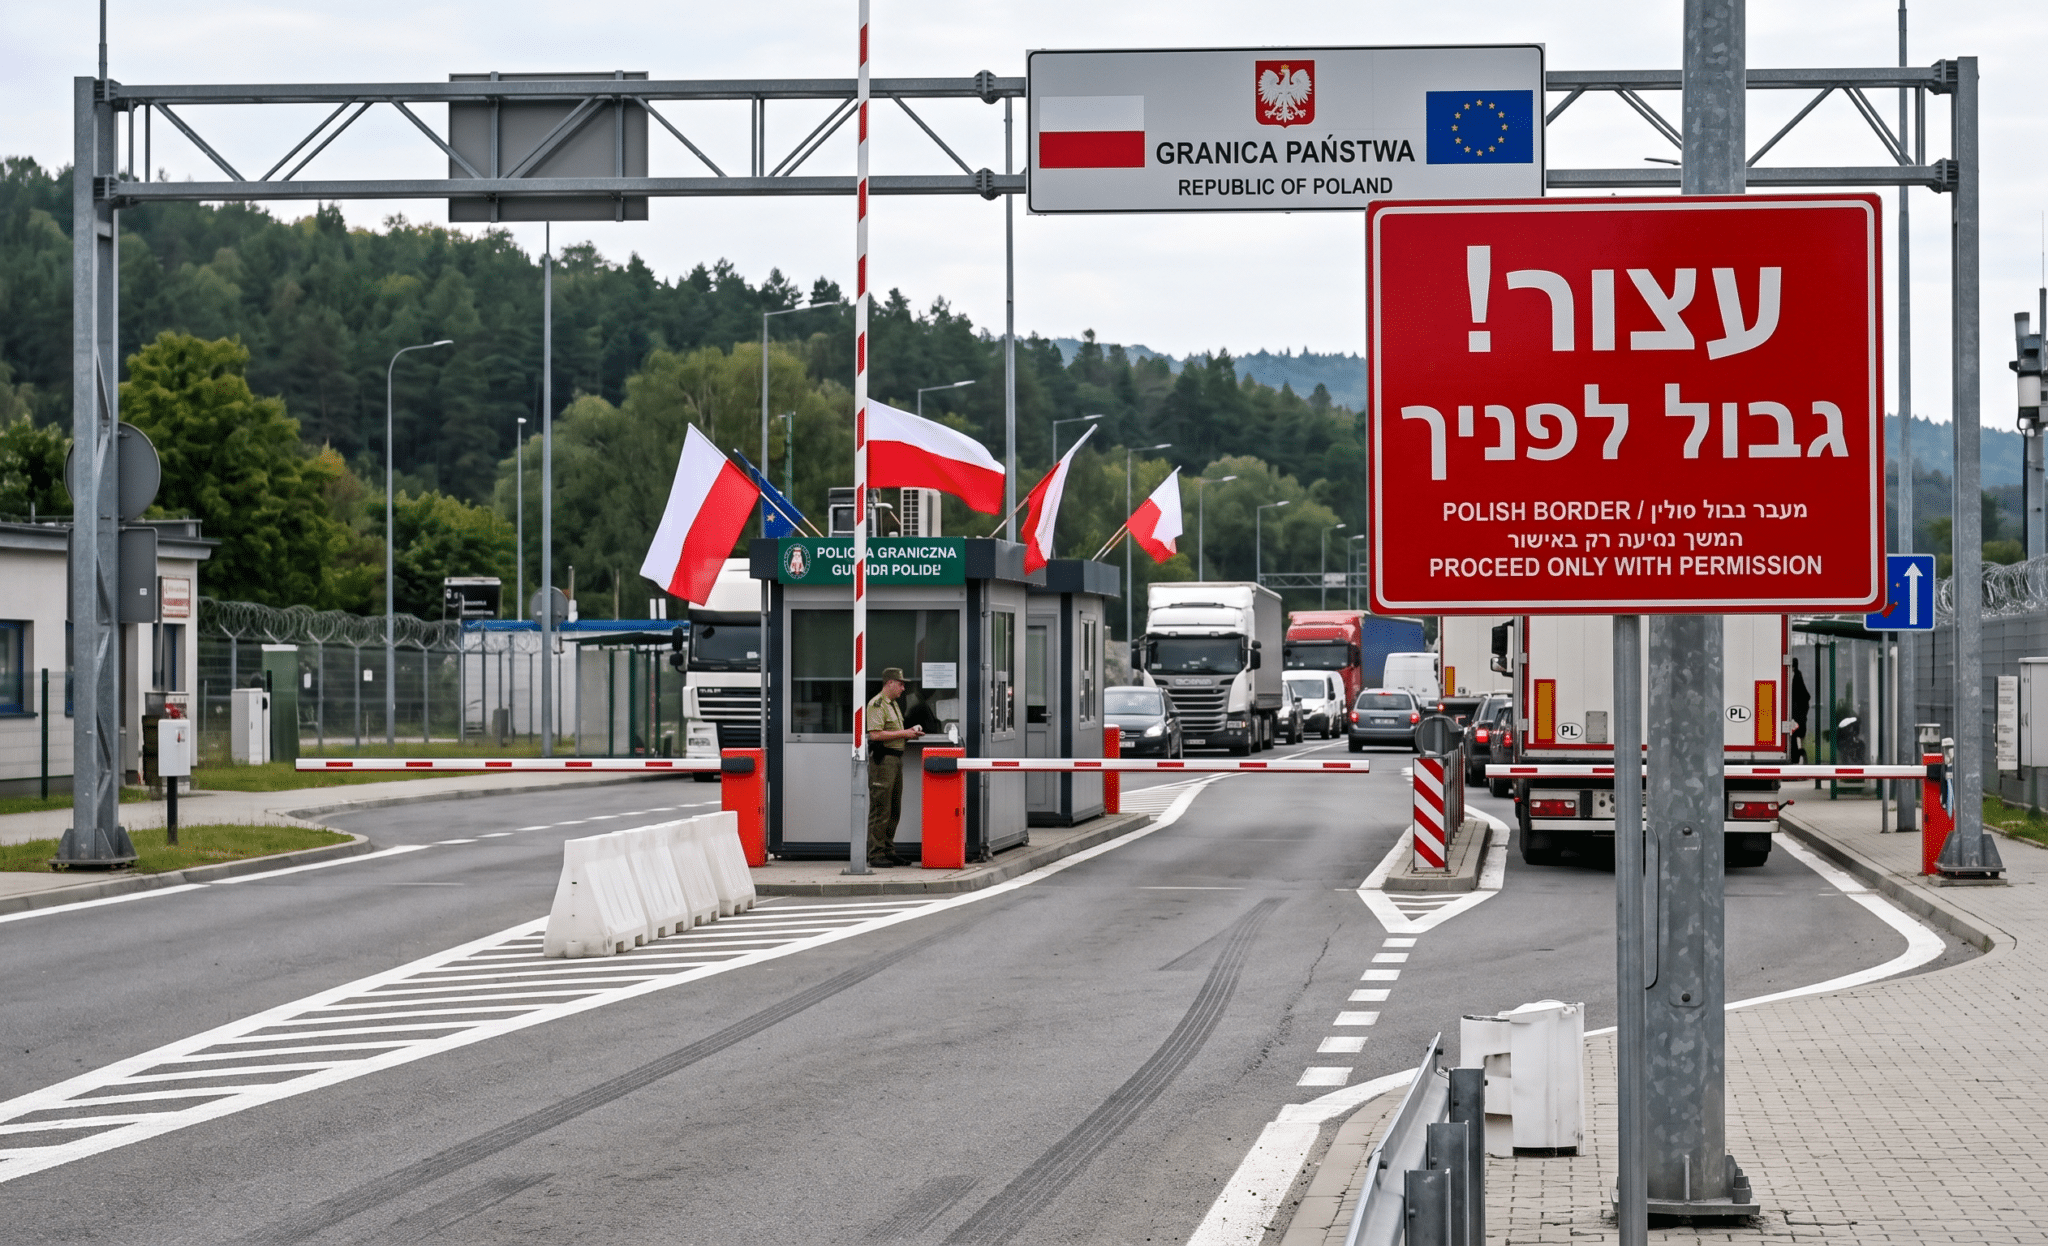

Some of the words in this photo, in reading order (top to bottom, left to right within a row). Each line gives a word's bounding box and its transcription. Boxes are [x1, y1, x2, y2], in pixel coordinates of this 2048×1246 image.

[1156, 140, 1278, 165] GRANICA
[1286, 134, 1416, 164] PAŃSTWA
[1178, 178, 1275, 196] REPUBLIC
[1281, 178, 1307, 195] OF
[1313, 177, 1393, 195] POLAND
[1466, 245, 1782, 361] עצור!
[1664, 383, 1849, 459] גבול
[1400, 383, 1629, 481] לפניך
[1443, 501, 1526, 522] POLISH
[1534, 500, 1631, 521] BORDER
[1752, 503, 1808, 520] מעבר
[1507, 533, 1579, 549] באישור
[1585, 533, 1611, 553] רק
[1683, 532, 1743, 551] המשך
[877, 546, 957, 559] GRANICZNA
[1430, 557, 1540, 578] PROCEED
[1547, 556, 1608, 577] ONLY
[1613, 556, 1672, 576] WITH
[1679, 555, 1822, 576] PERMISSION
[1730, 708, 1746, 719] PL
[1561, 725, 1578, 736] PL
